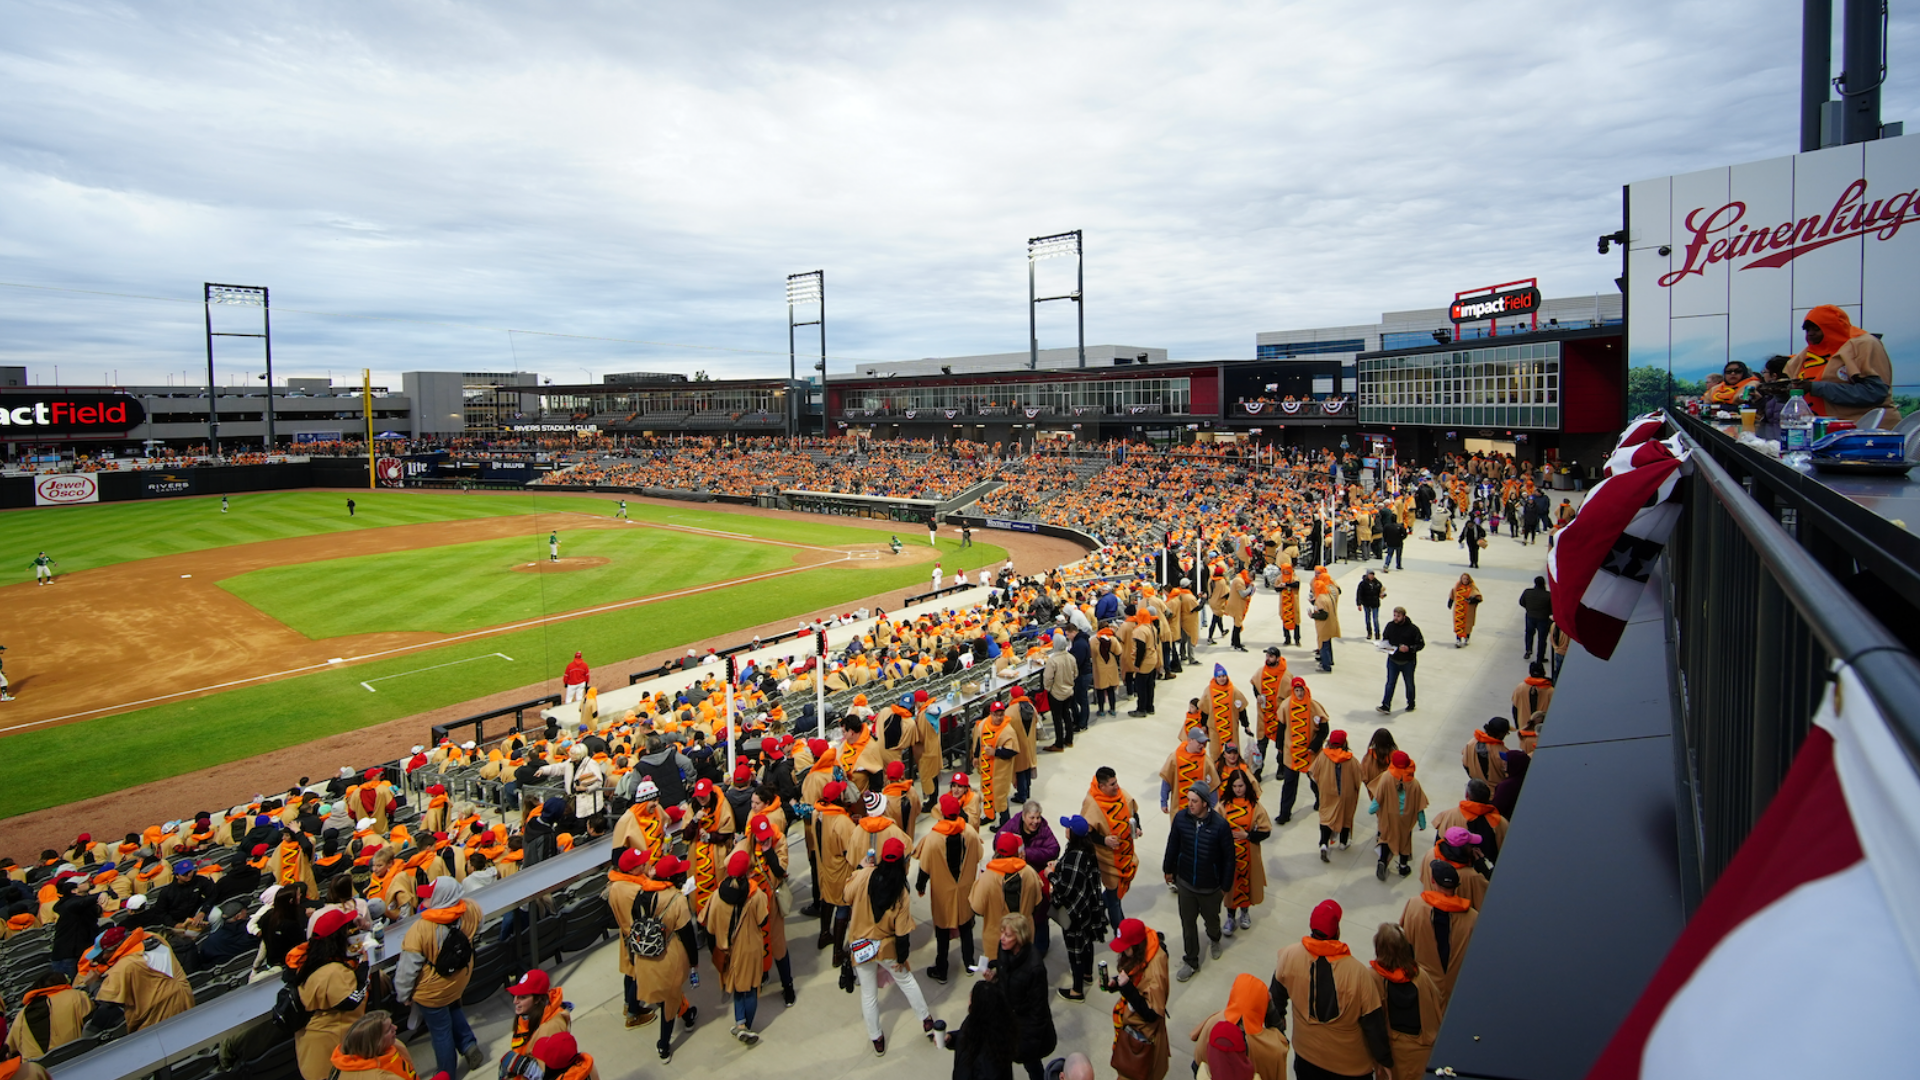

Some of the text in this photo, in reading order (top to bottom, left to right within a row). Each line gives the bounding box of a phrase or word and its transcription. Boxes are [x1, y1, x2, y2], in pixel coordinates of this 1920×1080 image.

[513, 424, 597, 432] RIVERS STADIUM CLUB
[407, 462, 427, 476] Lite
[46, 480, 86, 490] Jewel
[148, 482, 189, 490] RIVERS
[49, 489, 85, 498] Osco
